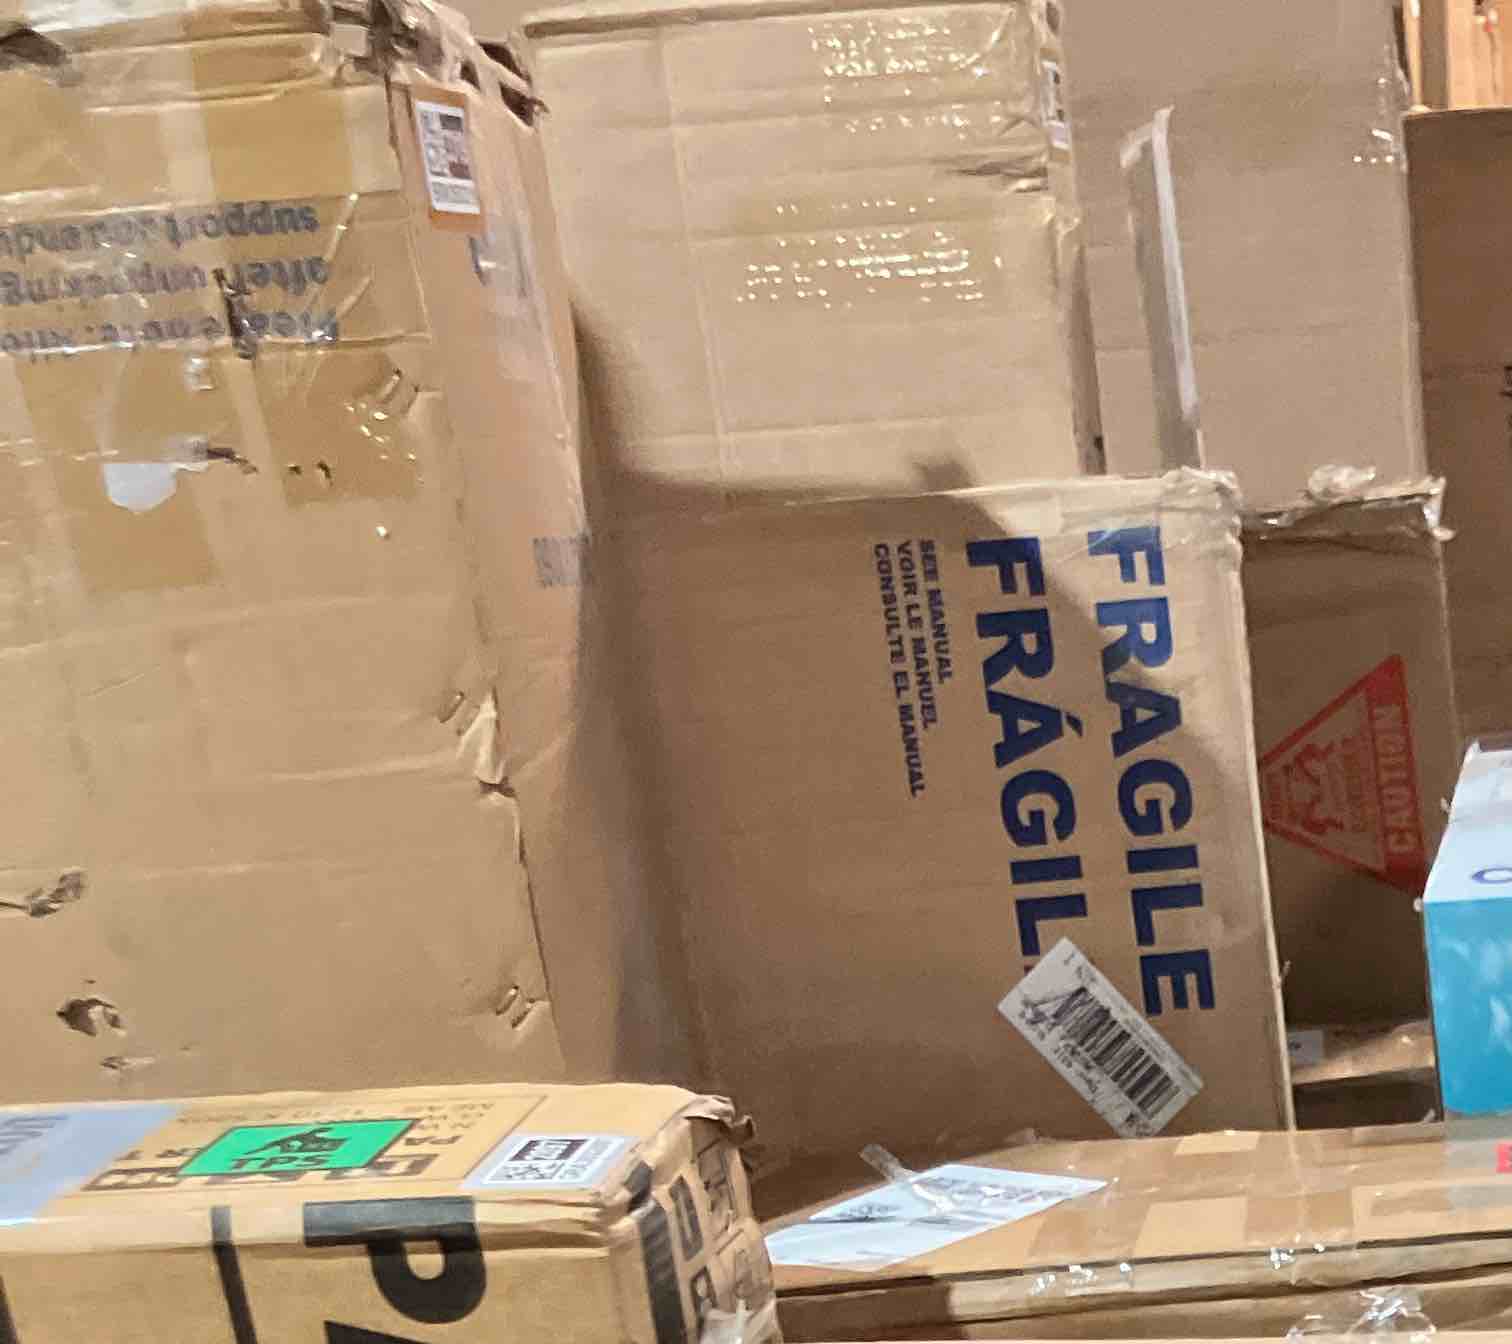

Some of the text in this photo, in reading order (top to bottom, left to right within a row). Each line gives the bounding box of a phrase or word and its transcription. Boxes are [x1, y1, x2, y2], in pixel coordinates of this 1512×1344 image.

[874, 543, 925, 798] CONSULTE EL MANUAL
[897, 540, 937, 729] VOIR LE MANUEL
[919, 539, 953, 684] SEE MANUAL
[965, 534, 1085, 958] FRÁGIL
[1087, 524, 1216, 1018] FRAGILE
[230, 1154, 331, 1170] TPS
